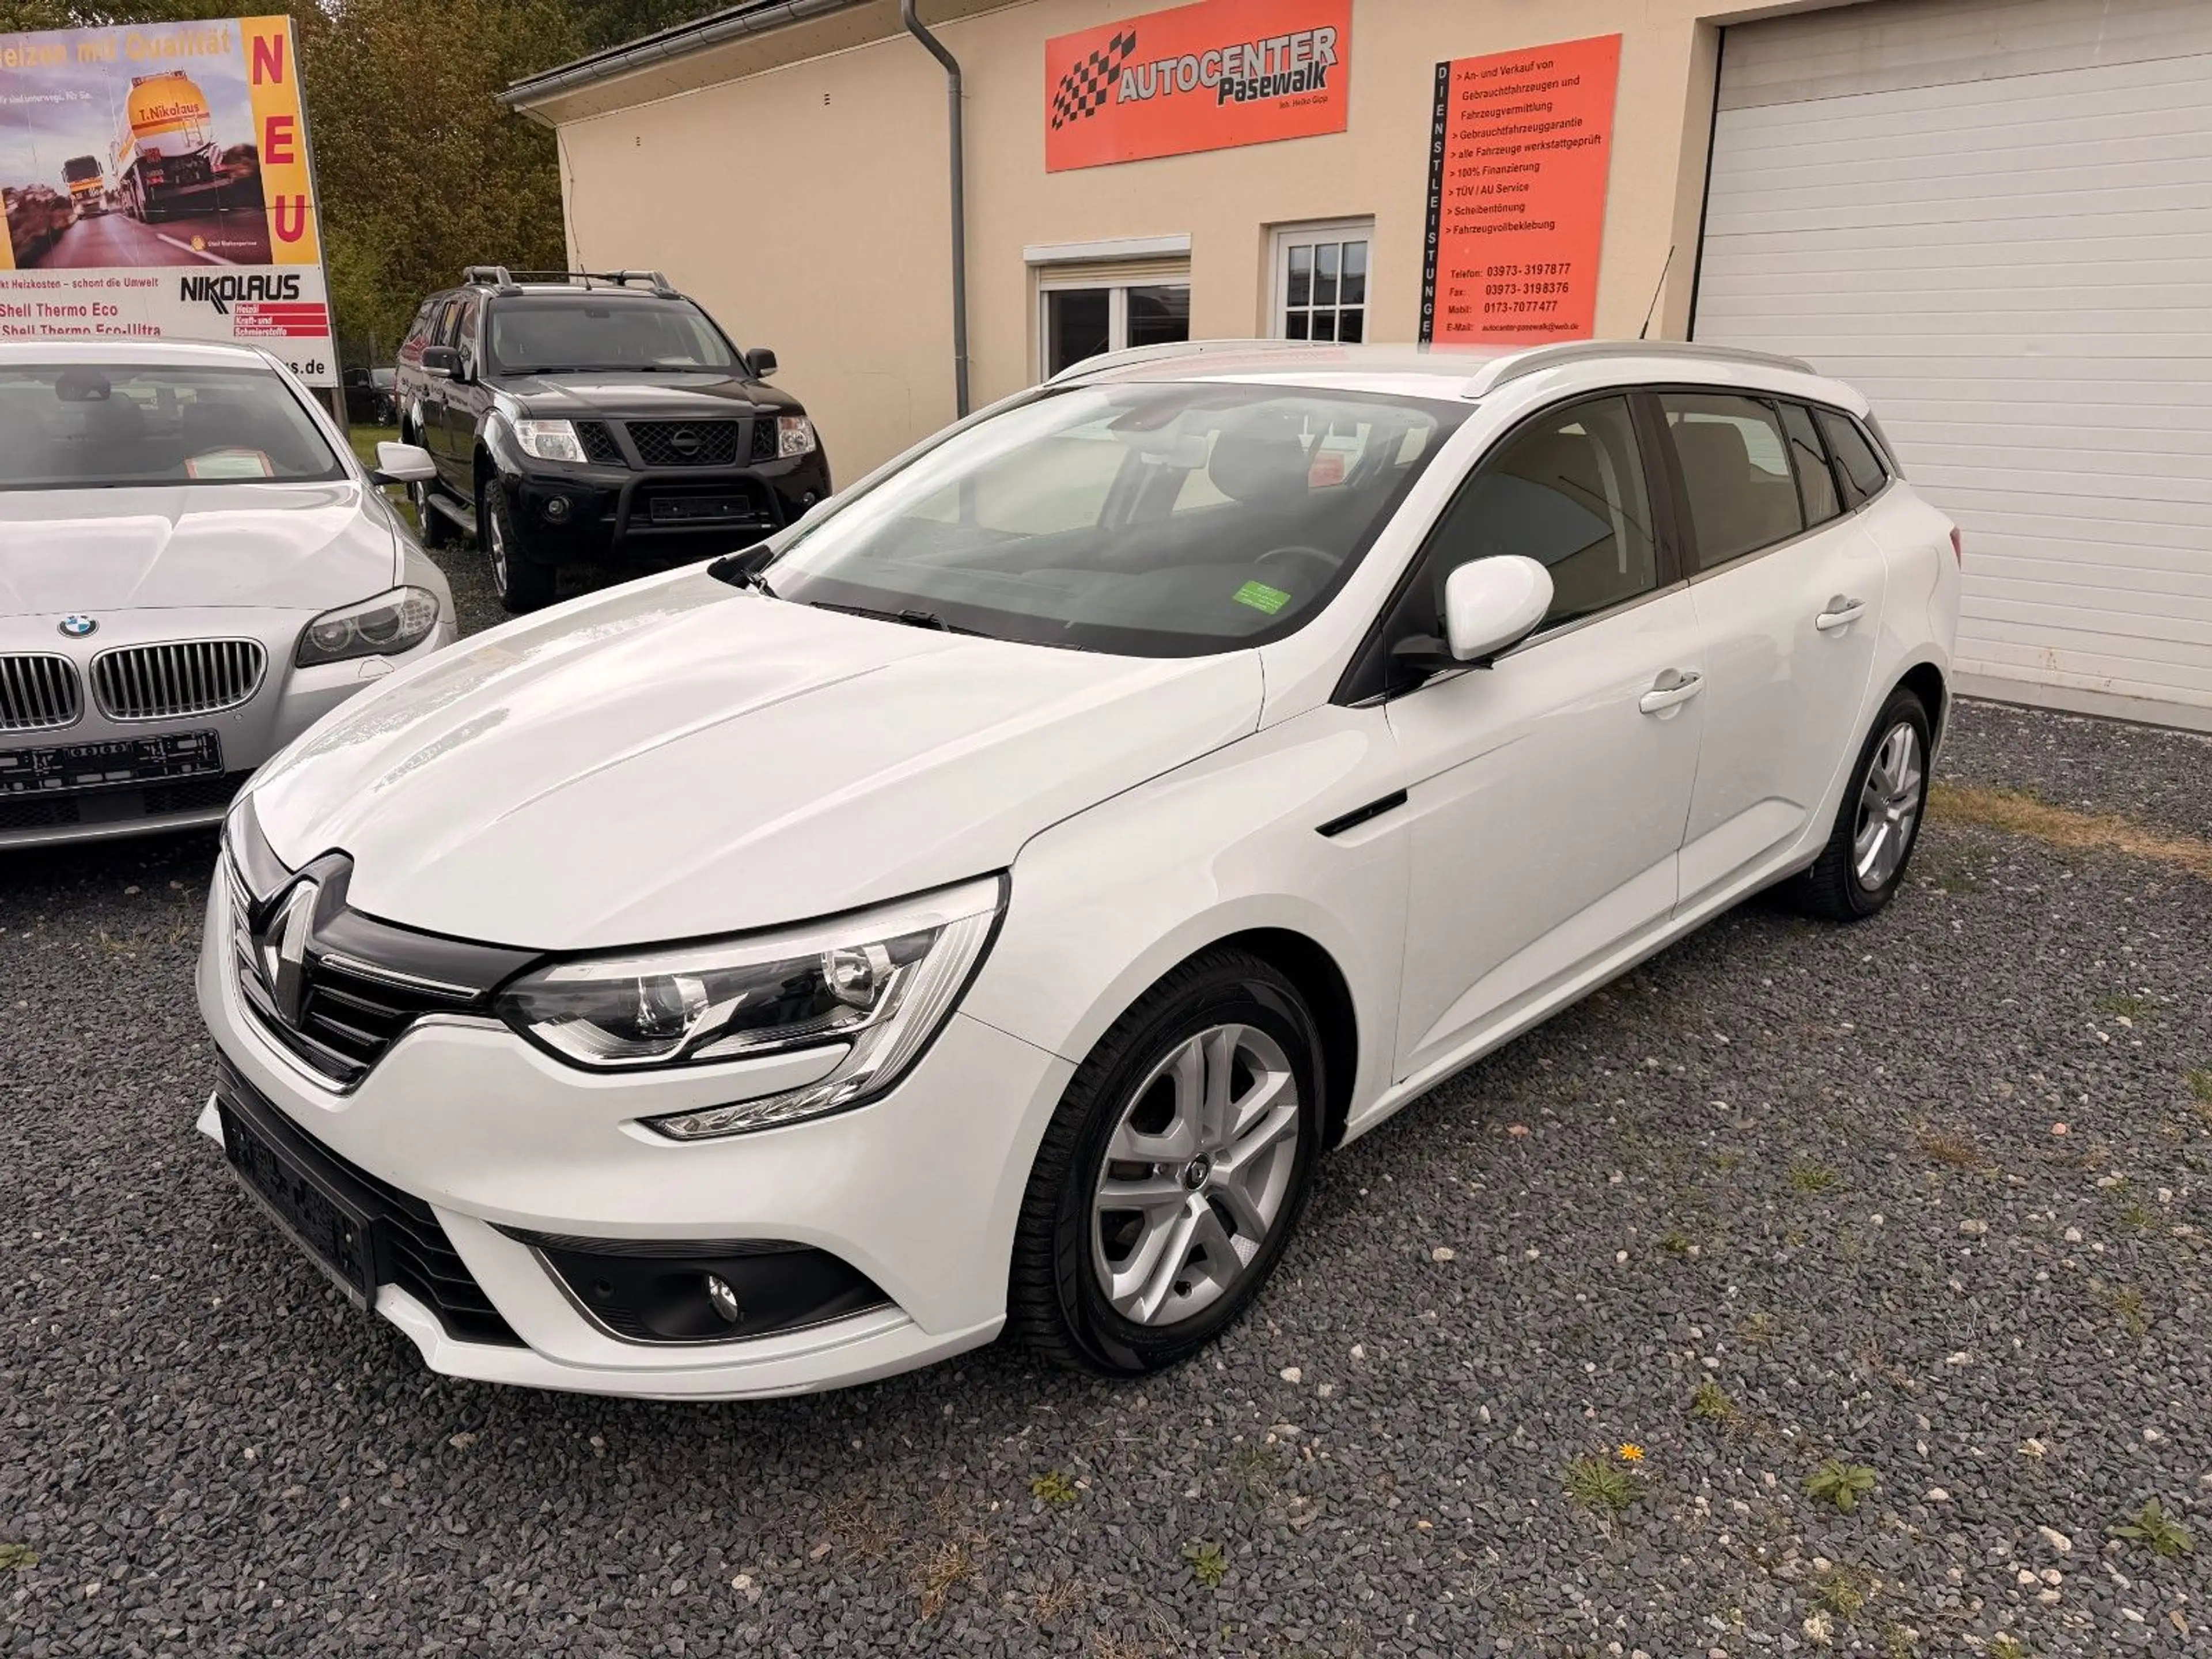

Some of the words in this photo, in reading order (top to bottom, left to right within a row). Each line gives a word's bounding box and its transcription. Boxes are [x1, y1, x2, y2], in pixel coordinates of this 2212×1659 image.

[0, 43, 67, 67] eizen
[127, 26, 231, 62] Qualität
[1116, 26, 1338, 104] AUTOCENTER
[1464, 71, 1479, 81] An-
[1481, 68, 1498, 79] und
[1500, 61, 1535, 76] Verkauf
[1536, 60, 1554, 70] von
[1217, 60, 1328, 107] Pasewalk
[1462, 81, 1559, 101] Gebrauchtfahrzeugen
[1561, 75, 1580, 87] und
[1460, 102, 1554, 121] Fahrzeugvermittlung
[1459, 118, 1583, 141] Gebrauchtfahrzeuggarantie
[1458, 147, 1473, 159] alle
[1476, 143, 1522, 157] Fahrzeuge
[1524, 134, 1601, 152] werkstattgeprüft
[1457, 166, 1480, 178] 100%
[1482, 162, 1540, 176] Finanzierung
[1456, 185, 1474, 197] TÜV
[1480, 185, 1494, 195] AU
[1495, 183, 1529, 194] Service
[1454, 203, 1526, 215] Scheibentönung
[1453, 221, 1556, 234] Fahrzeugvollbeklebung
[1450, 269, 1483, 279] Telefon:
[12, 279, 60, 289] Heizkosten
[72, 278, 104, 288] schont
[106, 278, 120, 287] die
[124, 277, 159, 287] Umwelt
[180, 275, 301, 315] NIKOLAUS
[0, 303, 31, 317] Shell
[36, 302, 87, 317] Thermo
[92, 302, 119, 317] Eco
[1448, 305, 1472, 314] Mobil:
[1484, 300, 1558, 313] 0173-7077477
[259, 316, 273, 325] und
[234, 327, 288, 336] Schmierstoffe
[286, 359, 325, 374] s.de
